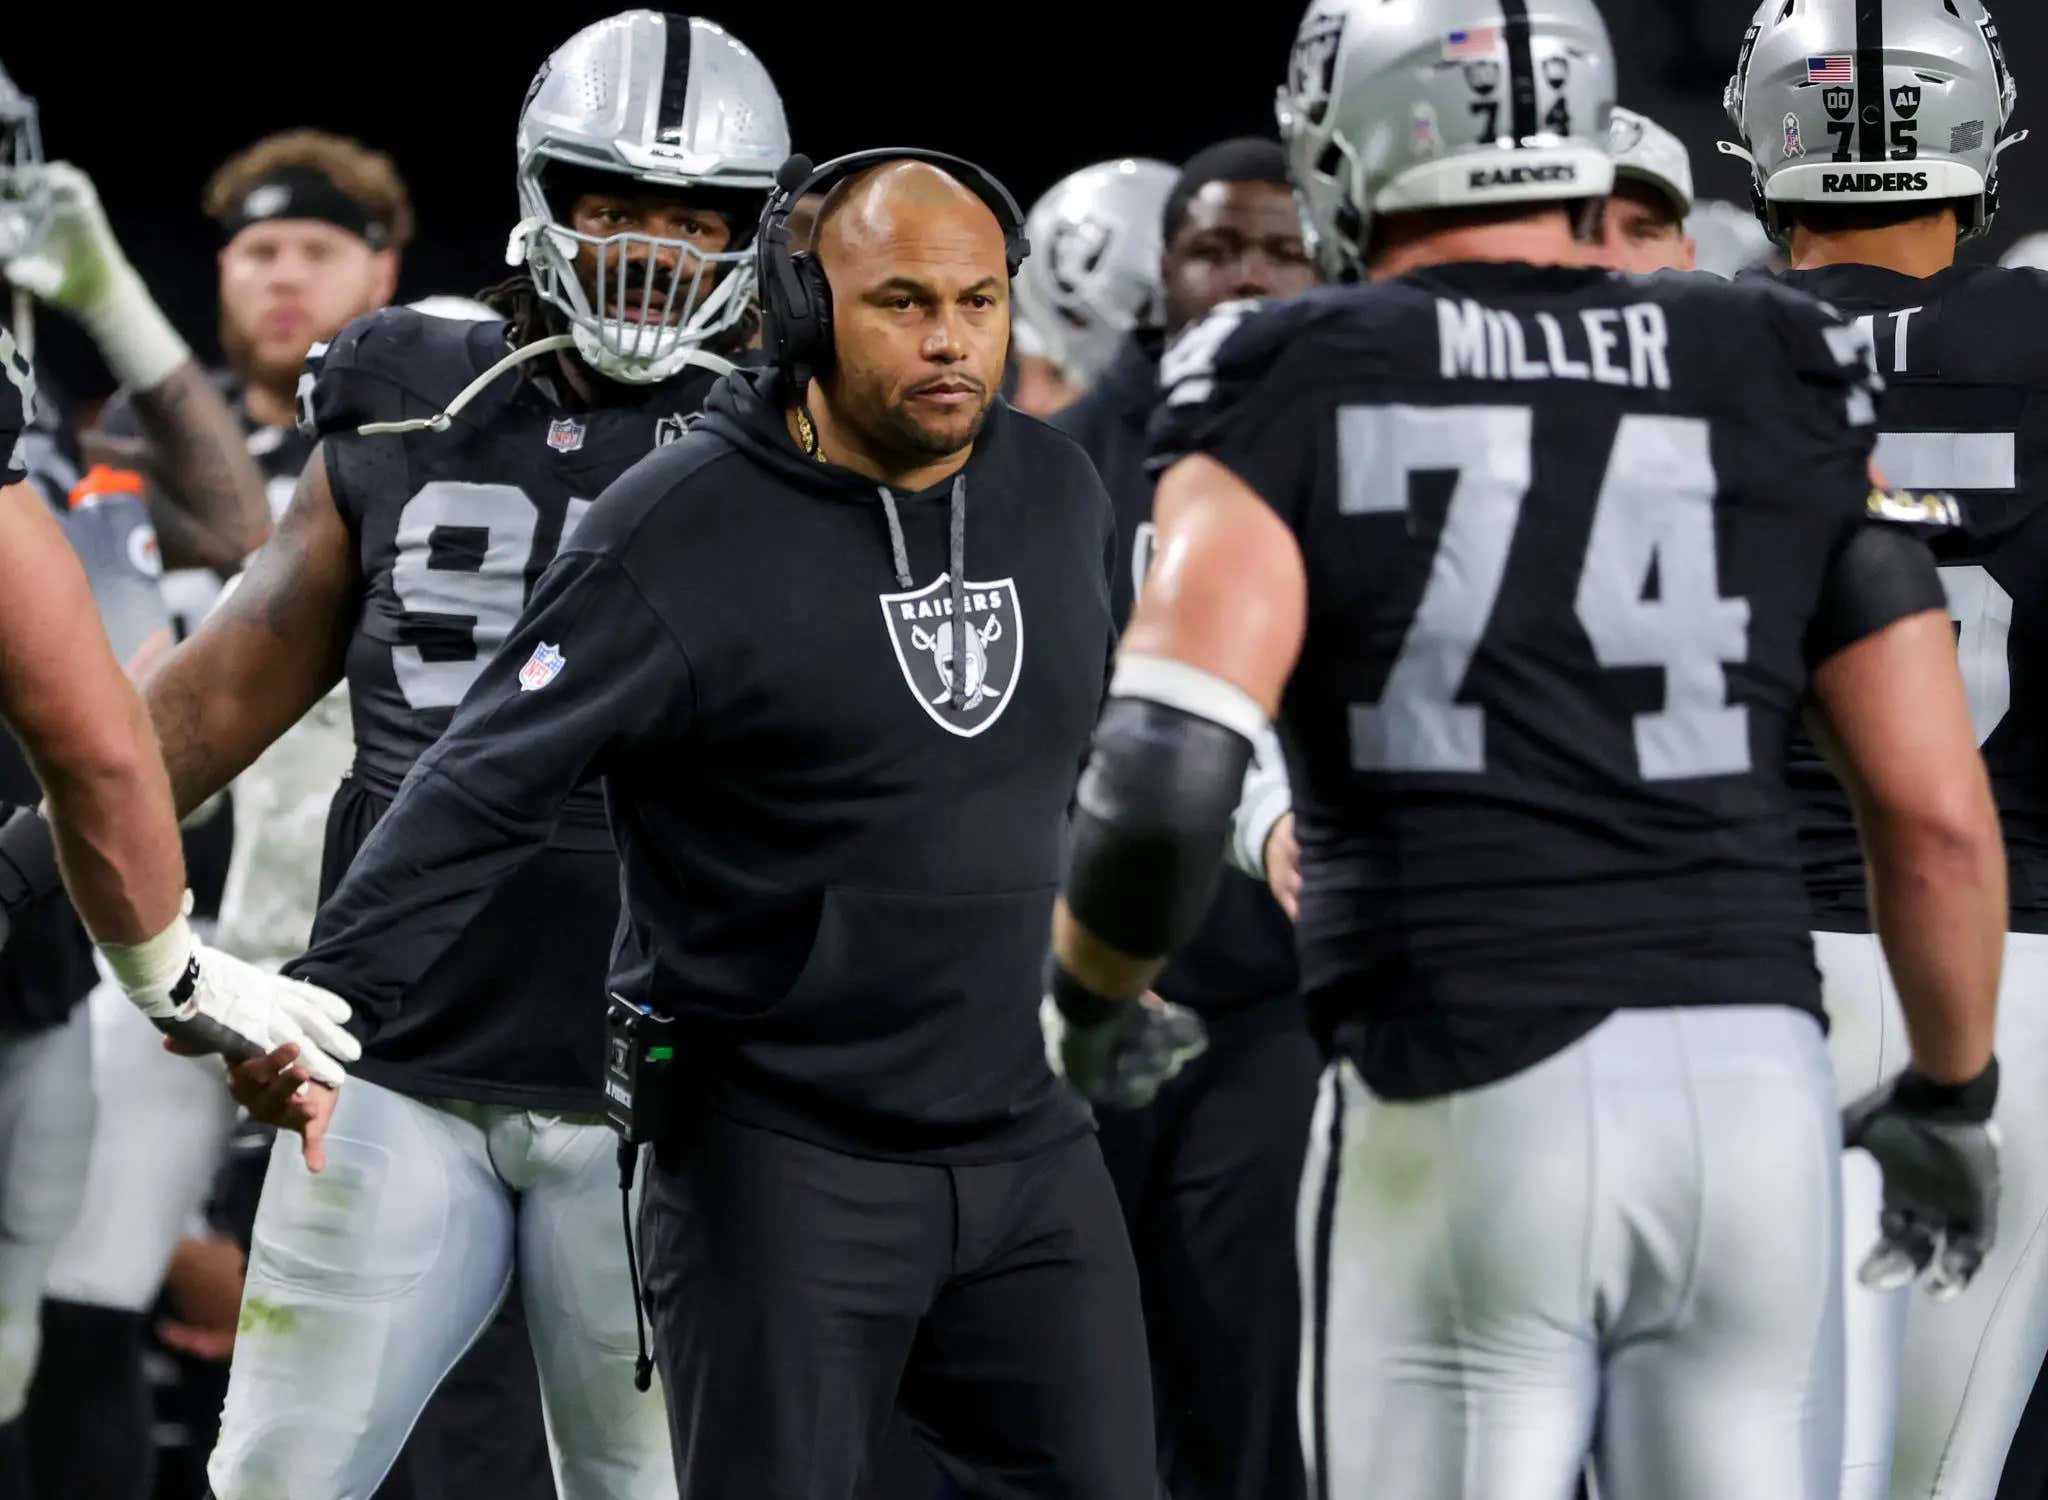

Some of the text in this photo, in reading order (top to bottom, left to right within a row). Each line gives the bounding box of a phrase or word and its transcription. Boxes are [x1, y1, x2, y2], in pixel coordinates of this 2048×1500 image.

[1895, 91, 1918, 107] AL
[1822, 171, 1928, 193] RAIDERS
[1435, 297, 1671, 389] MILLER
[1336, 404, 1752, 782] 74
